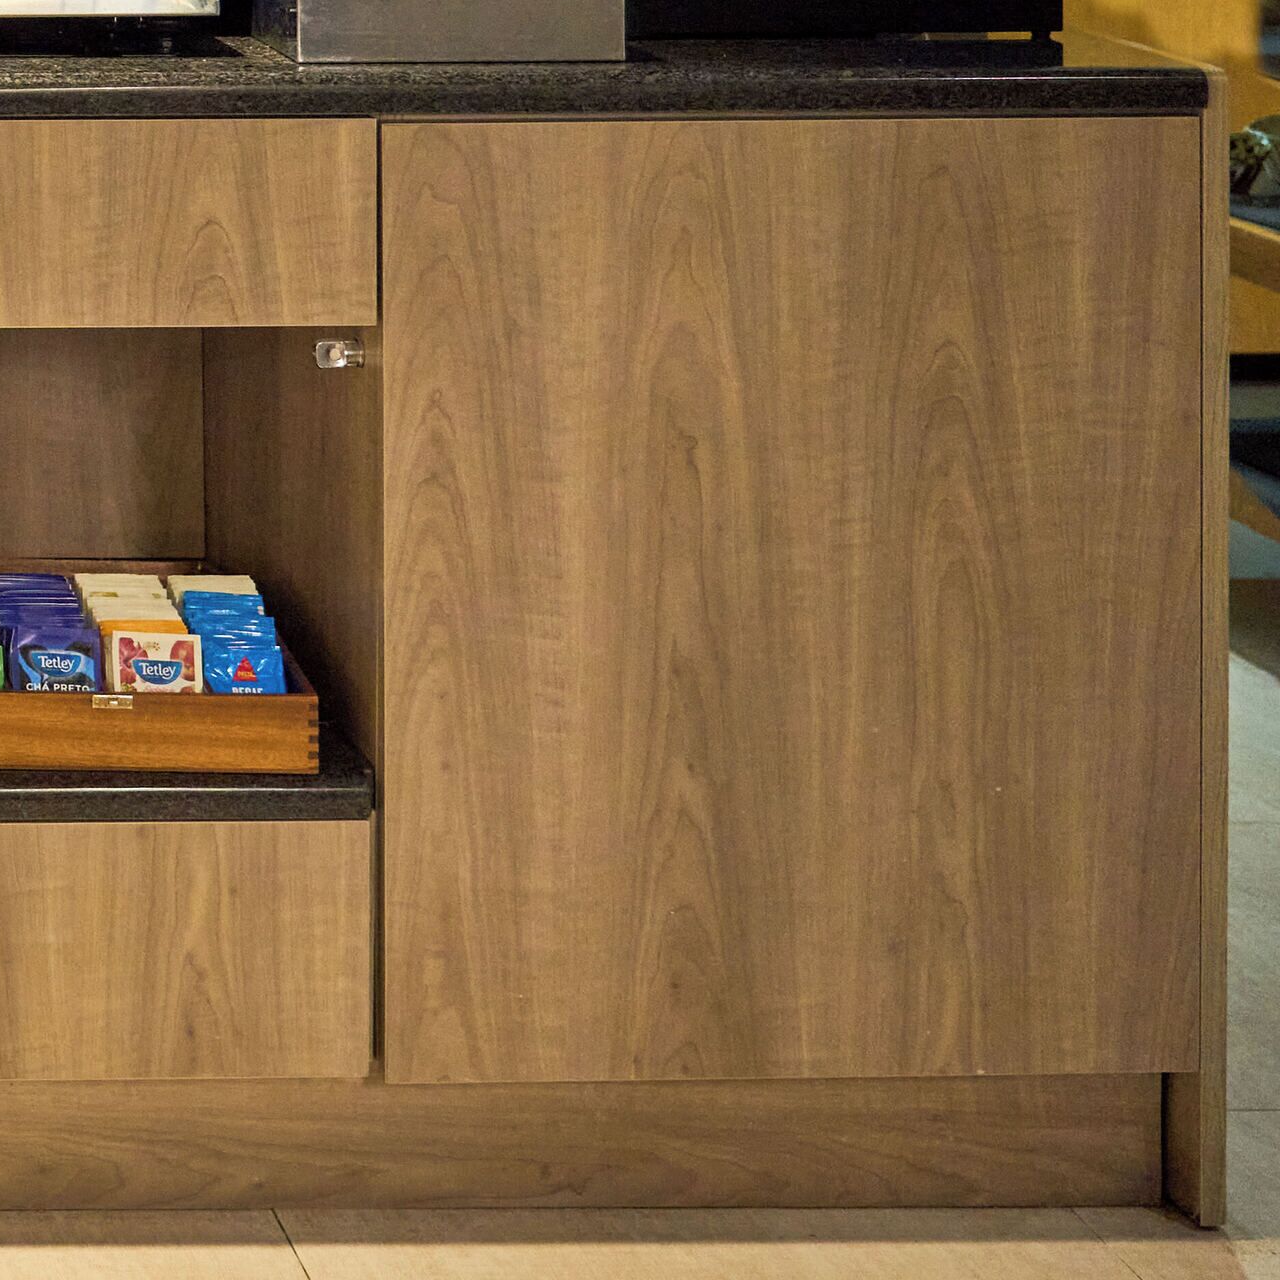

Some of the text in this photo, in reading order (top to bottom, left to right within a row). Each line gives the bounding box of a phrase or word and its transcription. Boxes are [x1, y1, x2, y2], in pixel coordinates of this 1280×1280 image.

[37, 656, 75, 673] Tetley
[139, 662, 176, 680] Tetley
[26, 681, 90, 691] CHÁ PRETO
